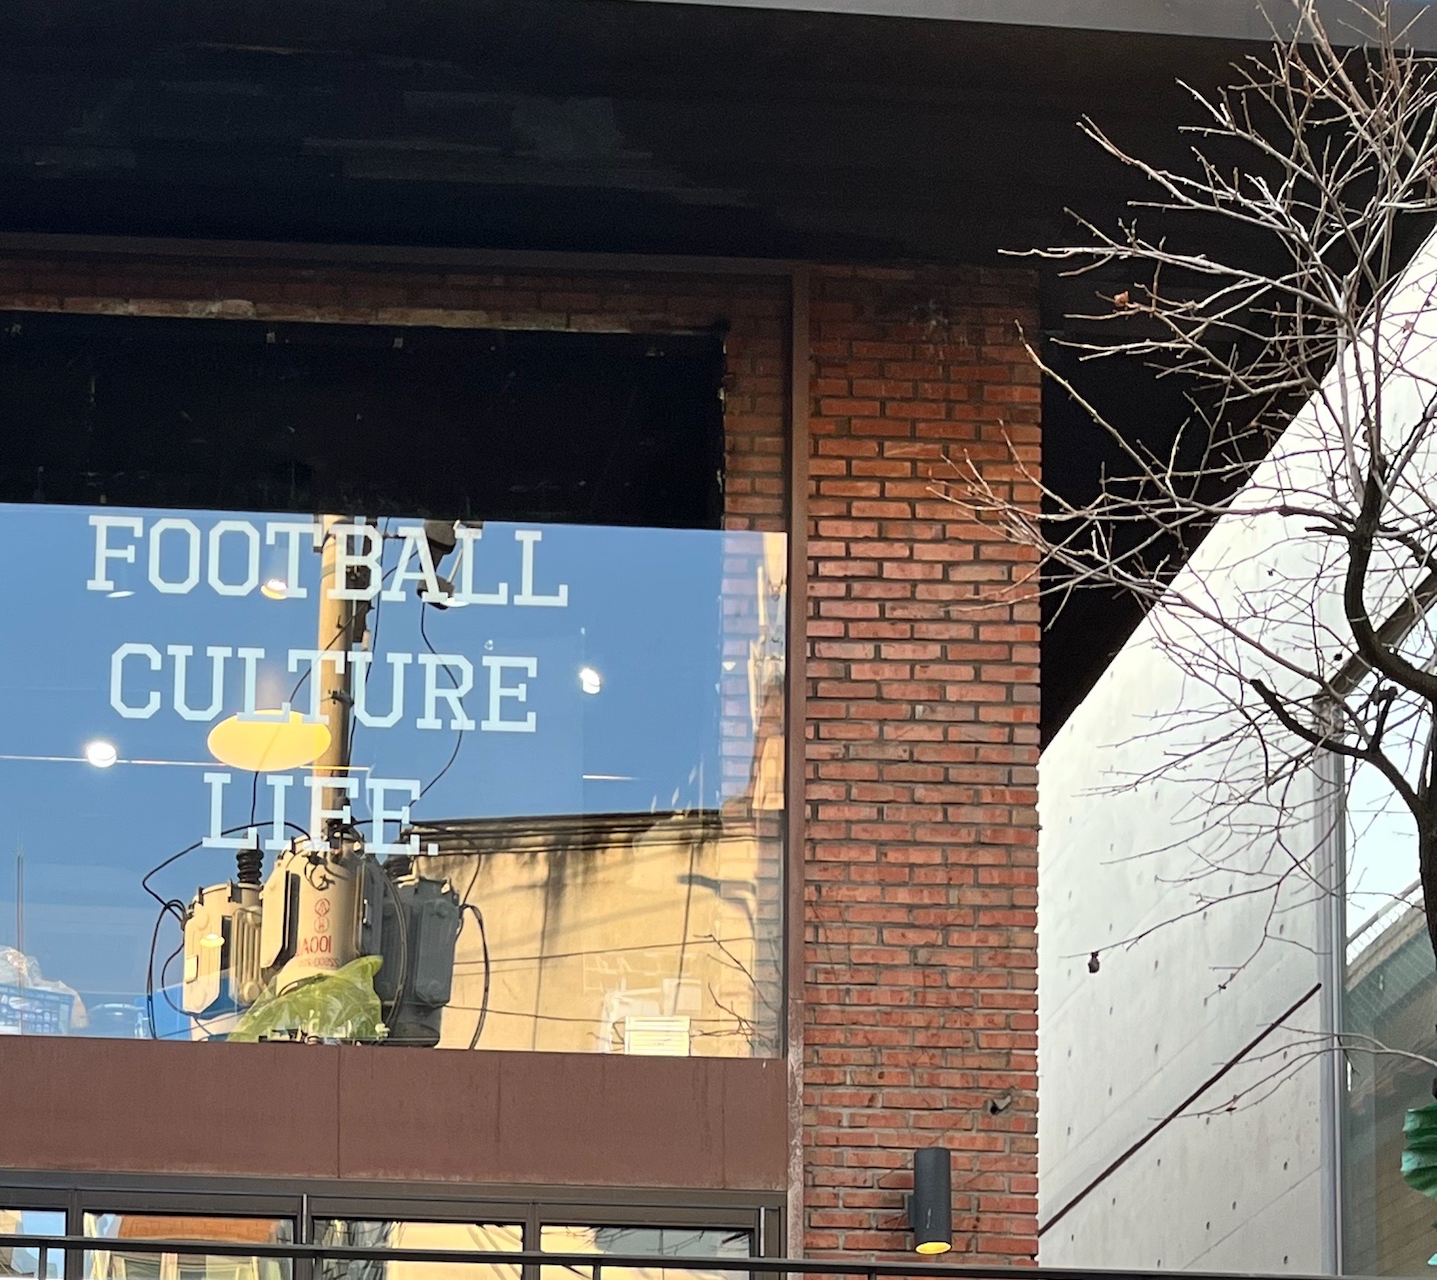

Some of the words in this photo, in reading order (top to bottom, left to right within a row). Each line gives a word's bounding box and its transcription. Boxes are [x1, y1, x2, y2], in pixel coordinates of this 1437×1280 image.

[86, 514, 569, 607] FOOTBALL
[109, 642, 538, 733] CULTURE
[201, 772, 439, 856] LIFE.
